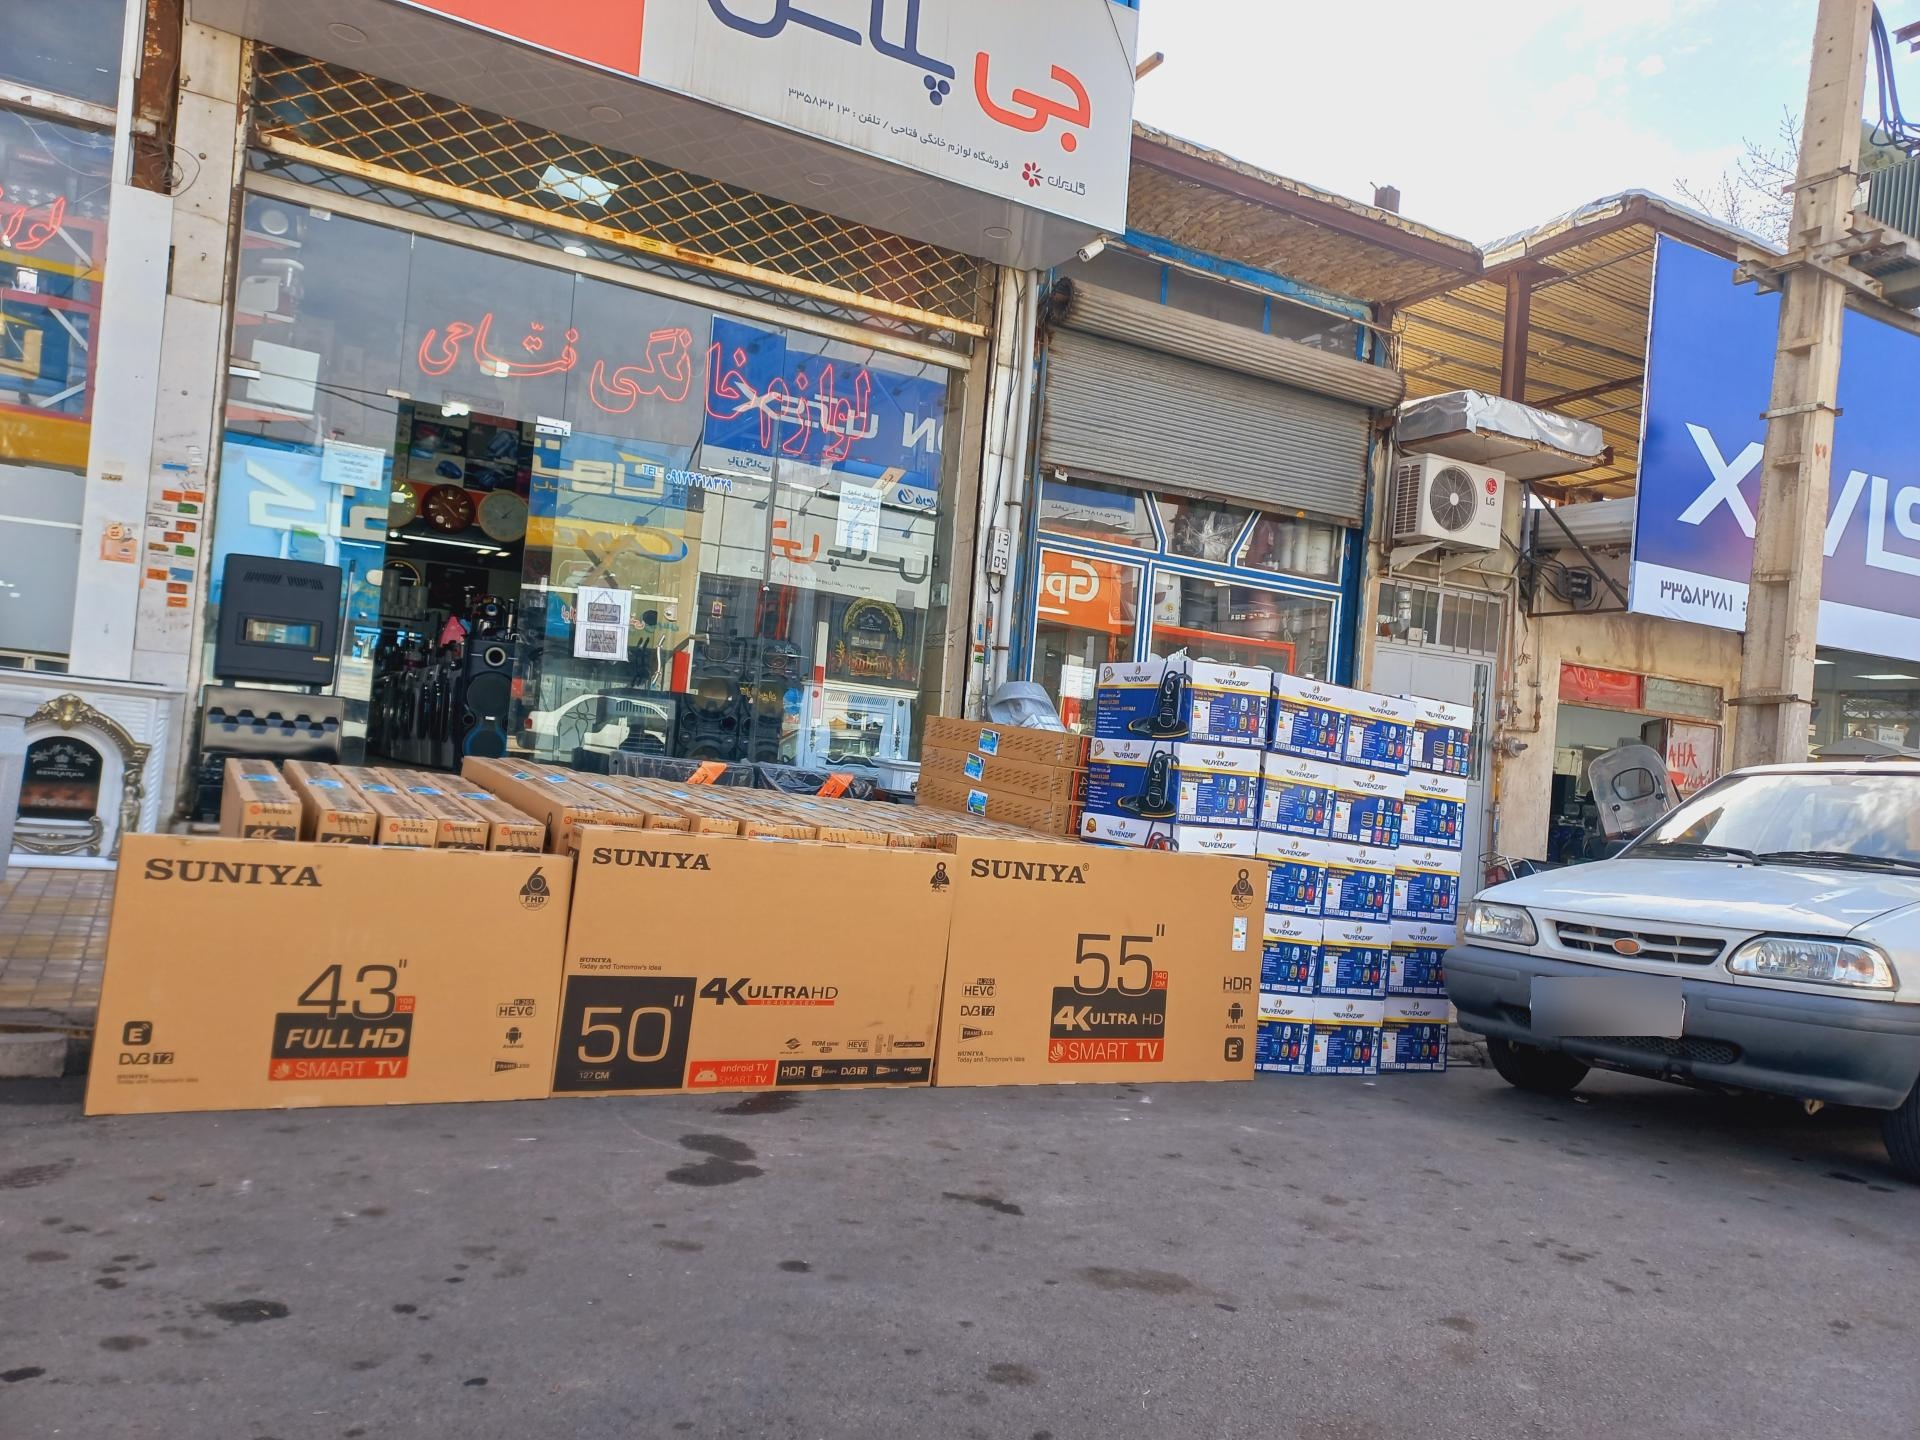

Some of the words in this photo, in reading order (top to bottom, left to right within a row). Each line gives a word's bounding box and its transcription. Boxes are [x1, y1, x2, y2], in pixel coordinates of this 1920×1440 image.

[974, 51, 1091, 152] جی
[858, 113, 881, 127] تلفن
[890, 124, 918, 140] فتاحی
[919, 131, 946, 149] خانگی
[947, 140, 972, 158] لوازم
[973, 152, 1010, 171] فروشگاه
[1485, 496, 1496, 507] LG
[592, 847, 711, 871] SUNIYA
[144, 858, 323, 887] SUNIYA
[970, 858, 1086, 885] SUNIYA
[700, 977, 751, 1006] 4K
[964, 985, 994, 996] HEVC
[1223, 976, 1252, 991] HDR
[499, 1006, 534, 1016] HEVC
[1053, 1005, 1093, 1031] 4K
[1089, 1012, 1138, 1025] ULTRA
[1142, 1013, 1164, 1025] HD
[285, 1028, 354, 1049] FULL
[358, 1028, 405, 1049] HD
[1068, 1042, 1129, 1060] SMART
[1136, 1042, 1159, 1060] TV
[295, 1061, 367, 1079] SMART
[375, 1060, 402, 1076] TV
[720, 1064, 755, 1073] android
[756, 1063, 769, 1072] TV
[781, 1066, 806, 1077] HDR
[755, 1075, 767, 1084] TV
